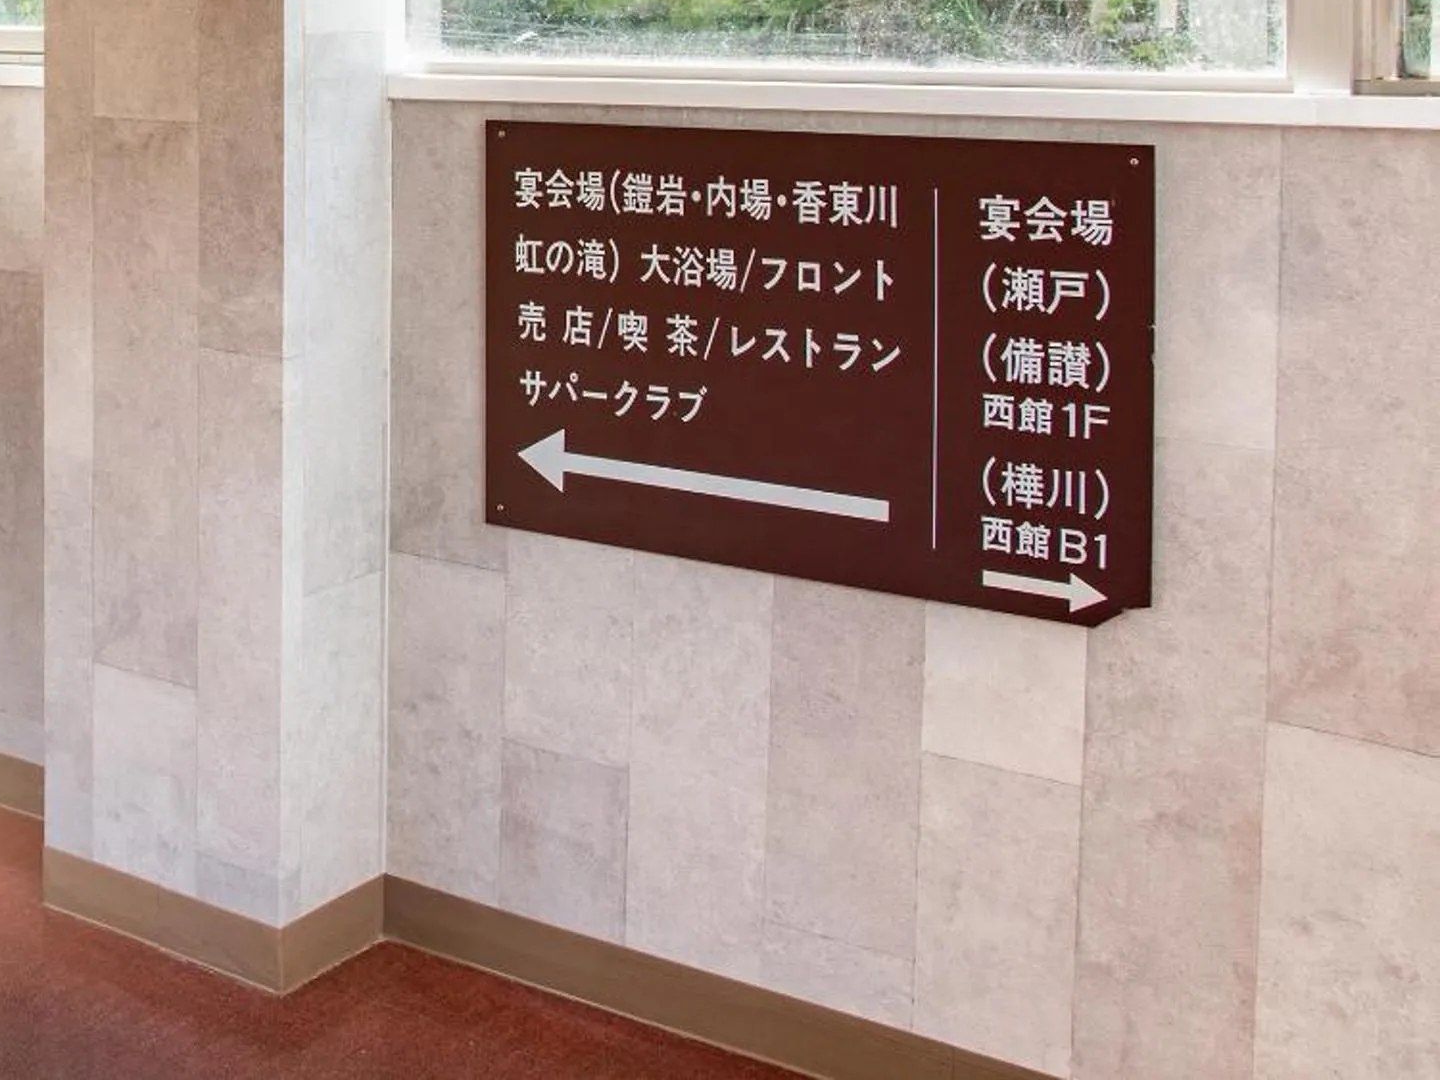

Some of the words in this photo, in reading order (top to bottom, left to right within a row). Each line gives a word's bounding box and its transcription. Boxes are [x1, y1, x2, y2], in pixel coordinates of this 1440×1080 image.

[979, 193, 1113, 246] 宴会場
[982, 262, 1110, 321] (瀬戸)
[982, 332, 1110, 393] (備讃)
[519, 369, 708, 423] サパークラブ
[982, 456, 1110, 521] (樺川)
